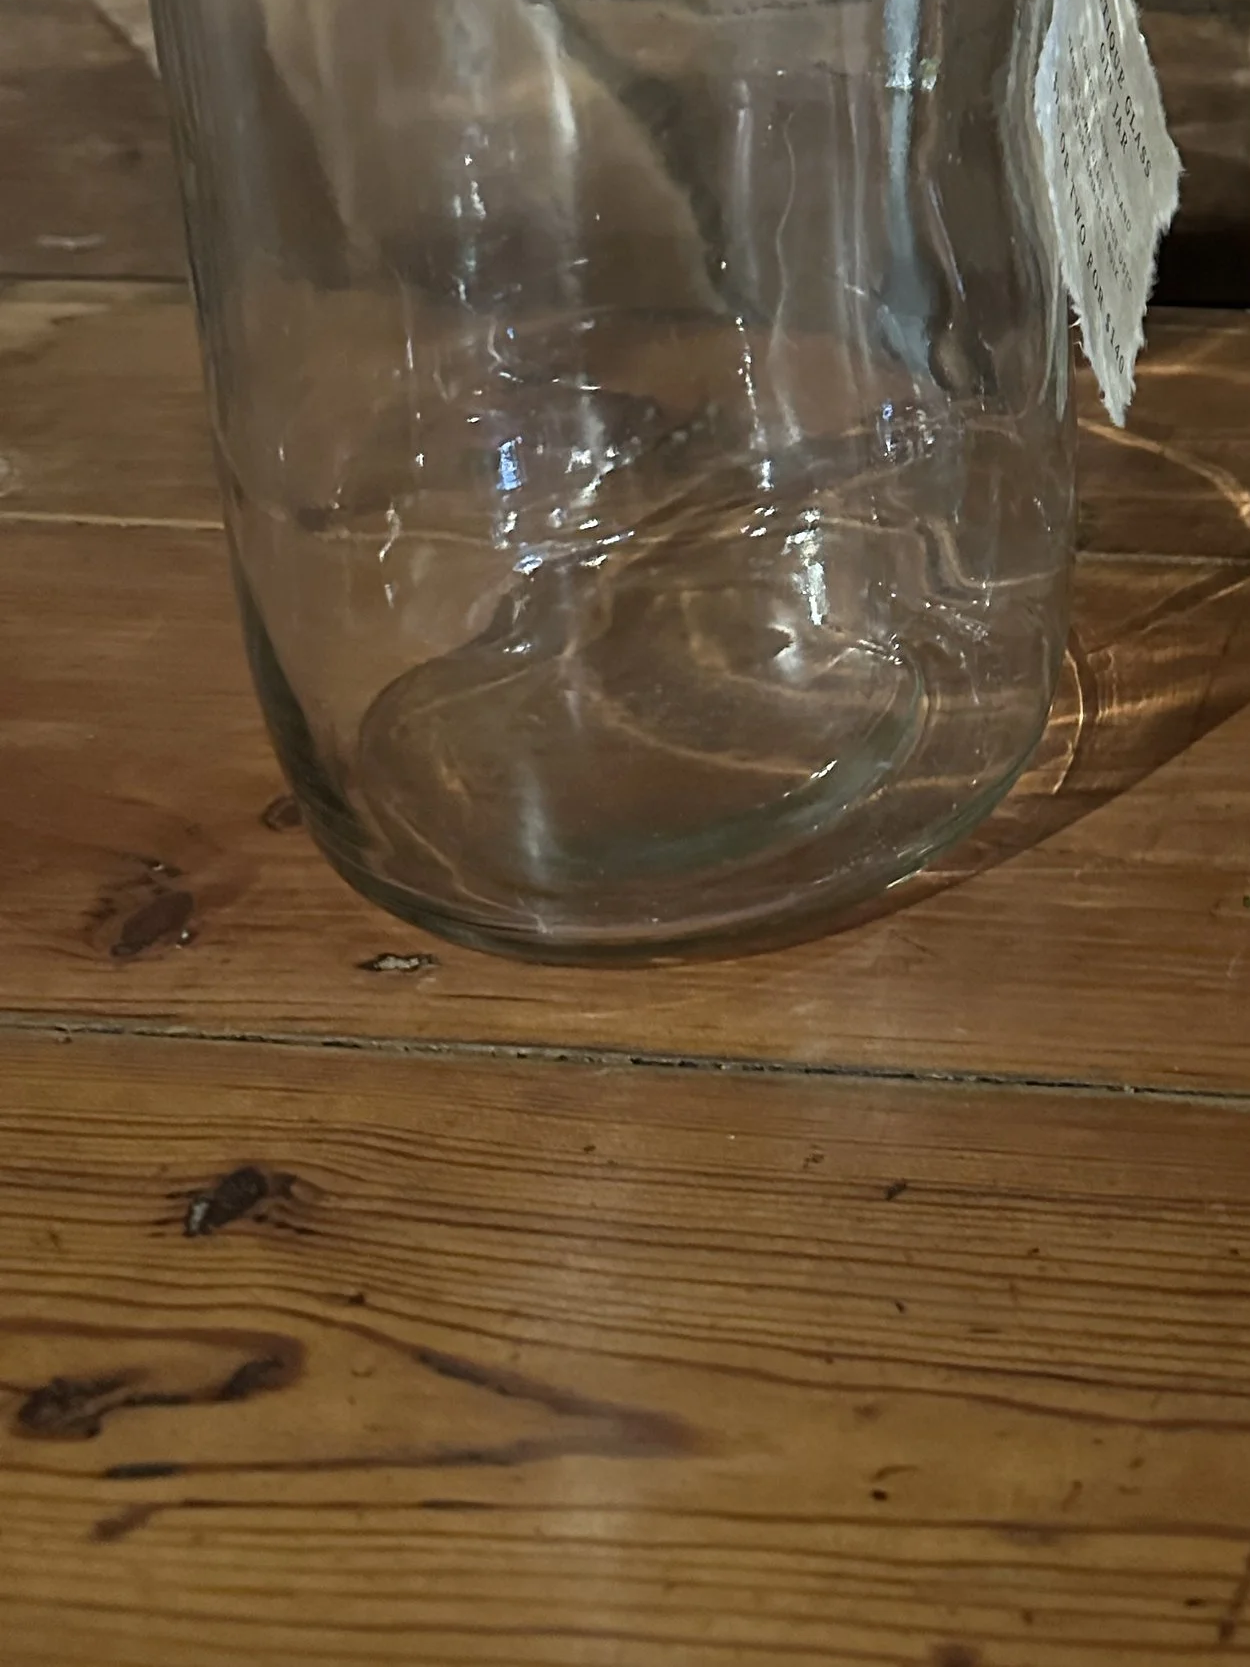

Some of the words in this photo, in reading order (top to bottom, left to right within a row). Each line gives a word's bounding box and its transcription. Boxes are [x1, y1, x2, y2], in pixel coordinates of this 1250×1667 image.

[1100, 42, 1114, 94] GIN
[1112, 102, 1128, 154] JAR
[1125, 95, 1152, 178] GLASS
[1108, 162, 1131, 232] ENGLAND
[1060, 132, 1069, 178] OR
[1070, 177, 1086, 246] TWO
[1086, 251, 1104, 309] FOR
[1105, 312, 1125, 375] $140
[1105, 206, 1118, 251] ONCE
[1118, 251, 1132, 292] USED
[1107, 241, 1119, 280] BULK
